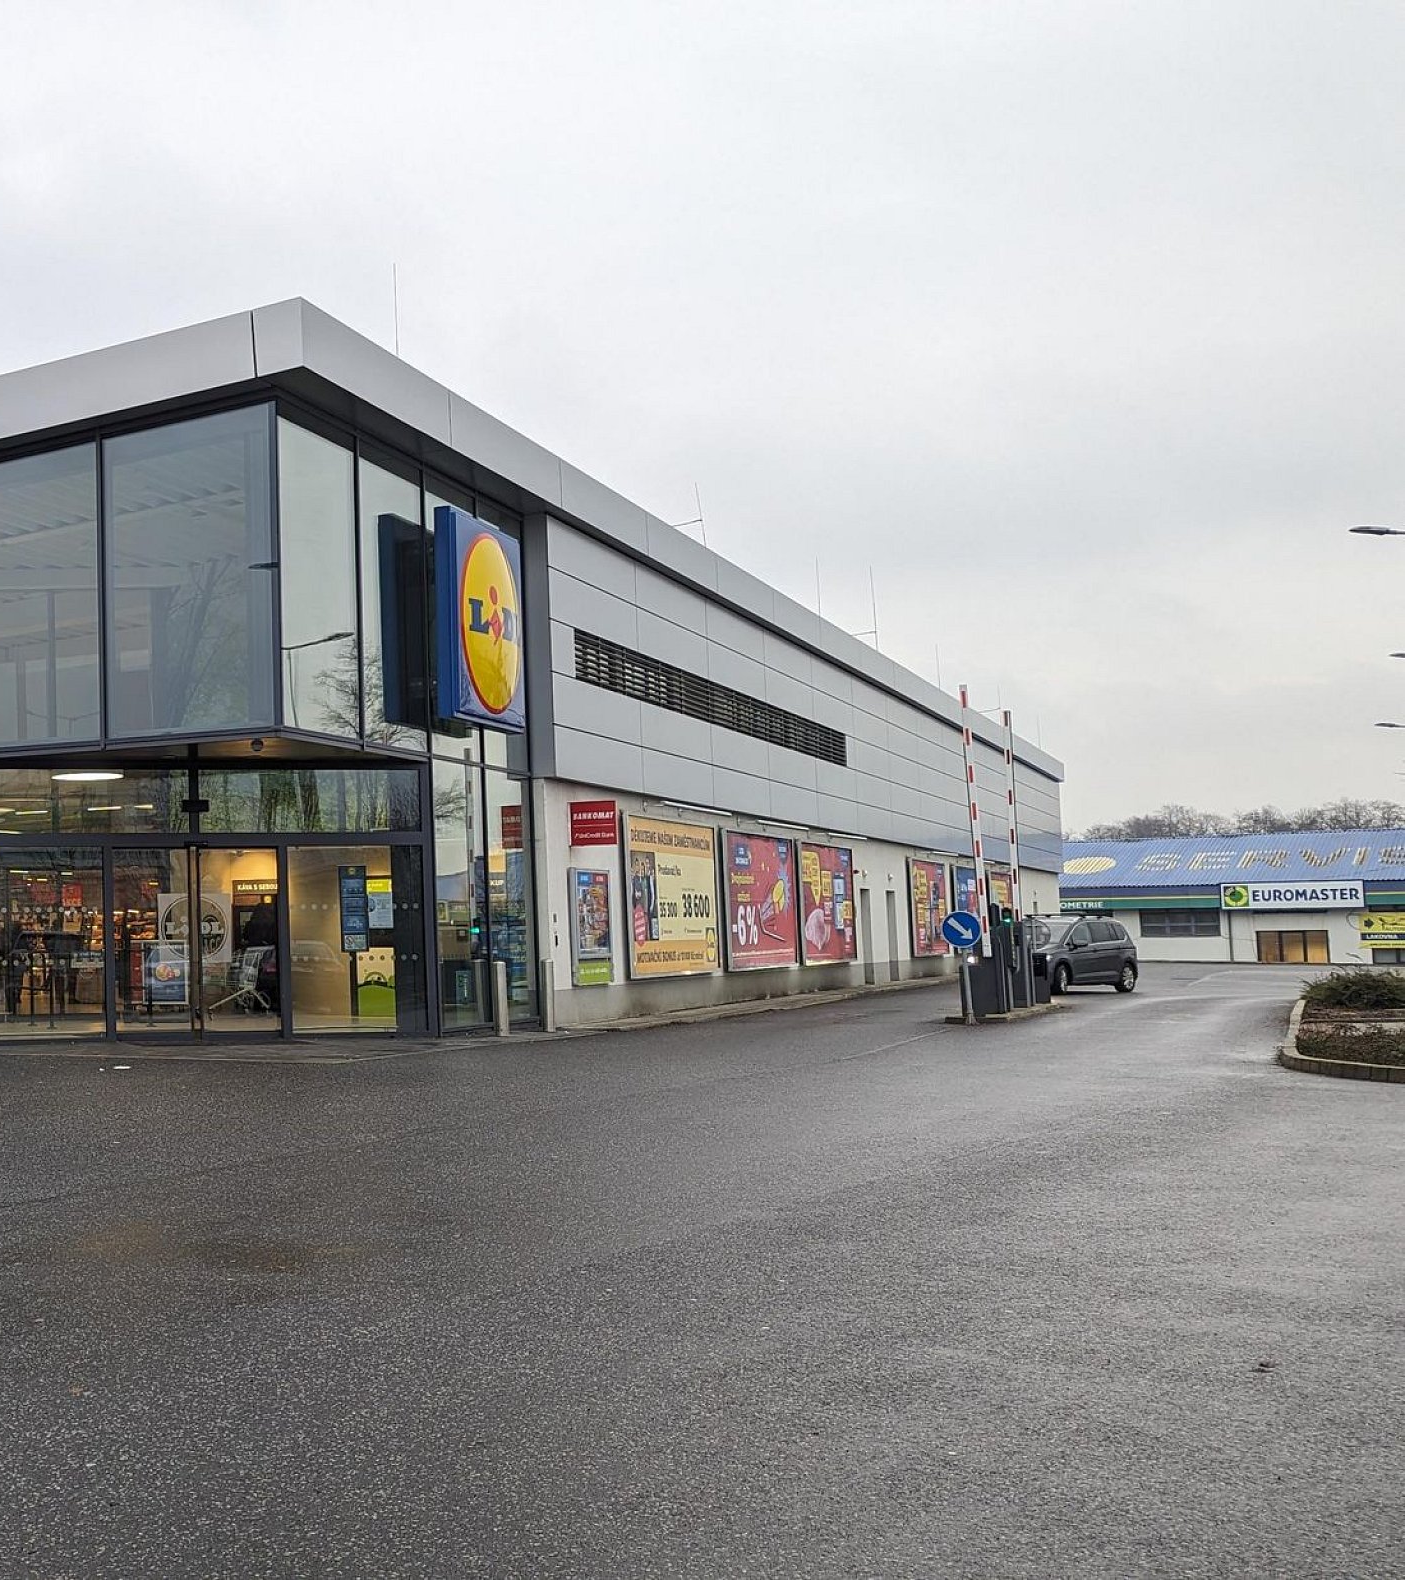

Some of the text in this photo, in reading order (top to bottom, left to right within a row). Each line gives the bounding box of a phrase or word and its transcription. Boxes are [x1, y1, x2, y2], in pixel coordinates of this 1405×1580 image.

[469, 585, 517, 645] LID
[573, 811, 614, 820] BANKOMAT
[1252, 887, 1360, 902] EUROMASTER
[732, 904, 759, 946] -6%
